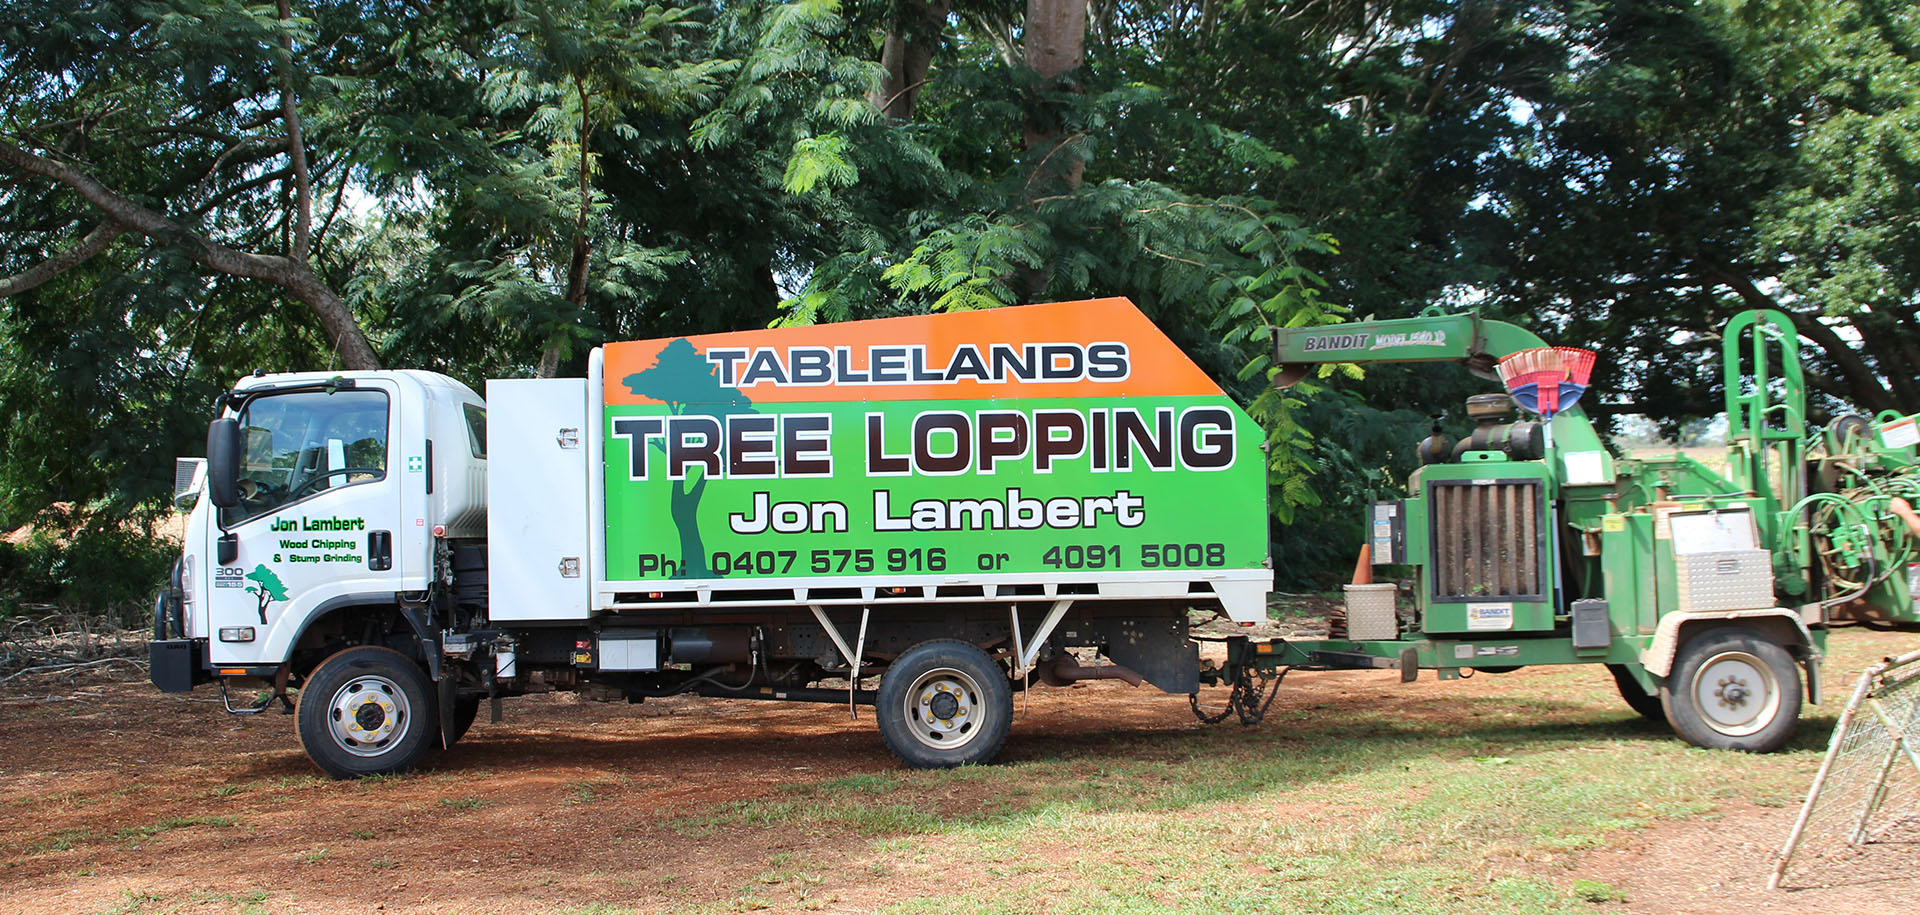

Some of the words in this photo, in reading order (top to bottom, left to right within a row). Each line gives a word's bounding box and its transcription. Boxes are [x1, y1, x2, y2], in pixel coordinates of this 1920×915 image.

[1303, 333, 1370, 352] BANDIT
[1376, 333, 1406, 346] MODEL
[706, 341, 1131, 388] TABLELANDS
[612, 413, 833, 481] TREE
[865, 406, 1237, 477] LOPPING
[729, 491, 848, 534] Jon
[873, 487, 1146, 533] Lambert
[270, 516, 298, 531] Jon
[303, 515, 365, 531] Lambert
[279, 539, 308, 549] Wood
[311, 539, 356, 550] Chipping
[273, 553, 282, 563] &
[289, 554, 321, 563] Stump
[323, 553, 362, 563] Grinding
[639, 554, 686, 577] Ph:
[711, 551, 797, 576] 0407
[811, 549, 874, 573] 575
[887, 548, 946, 572] 916
[977, 552, 1009, 570] or
[1043, 545, 1121, 569] 4091
[1141, 543, 1226, 567] 5008
[215, 567, 244, 576] 300
